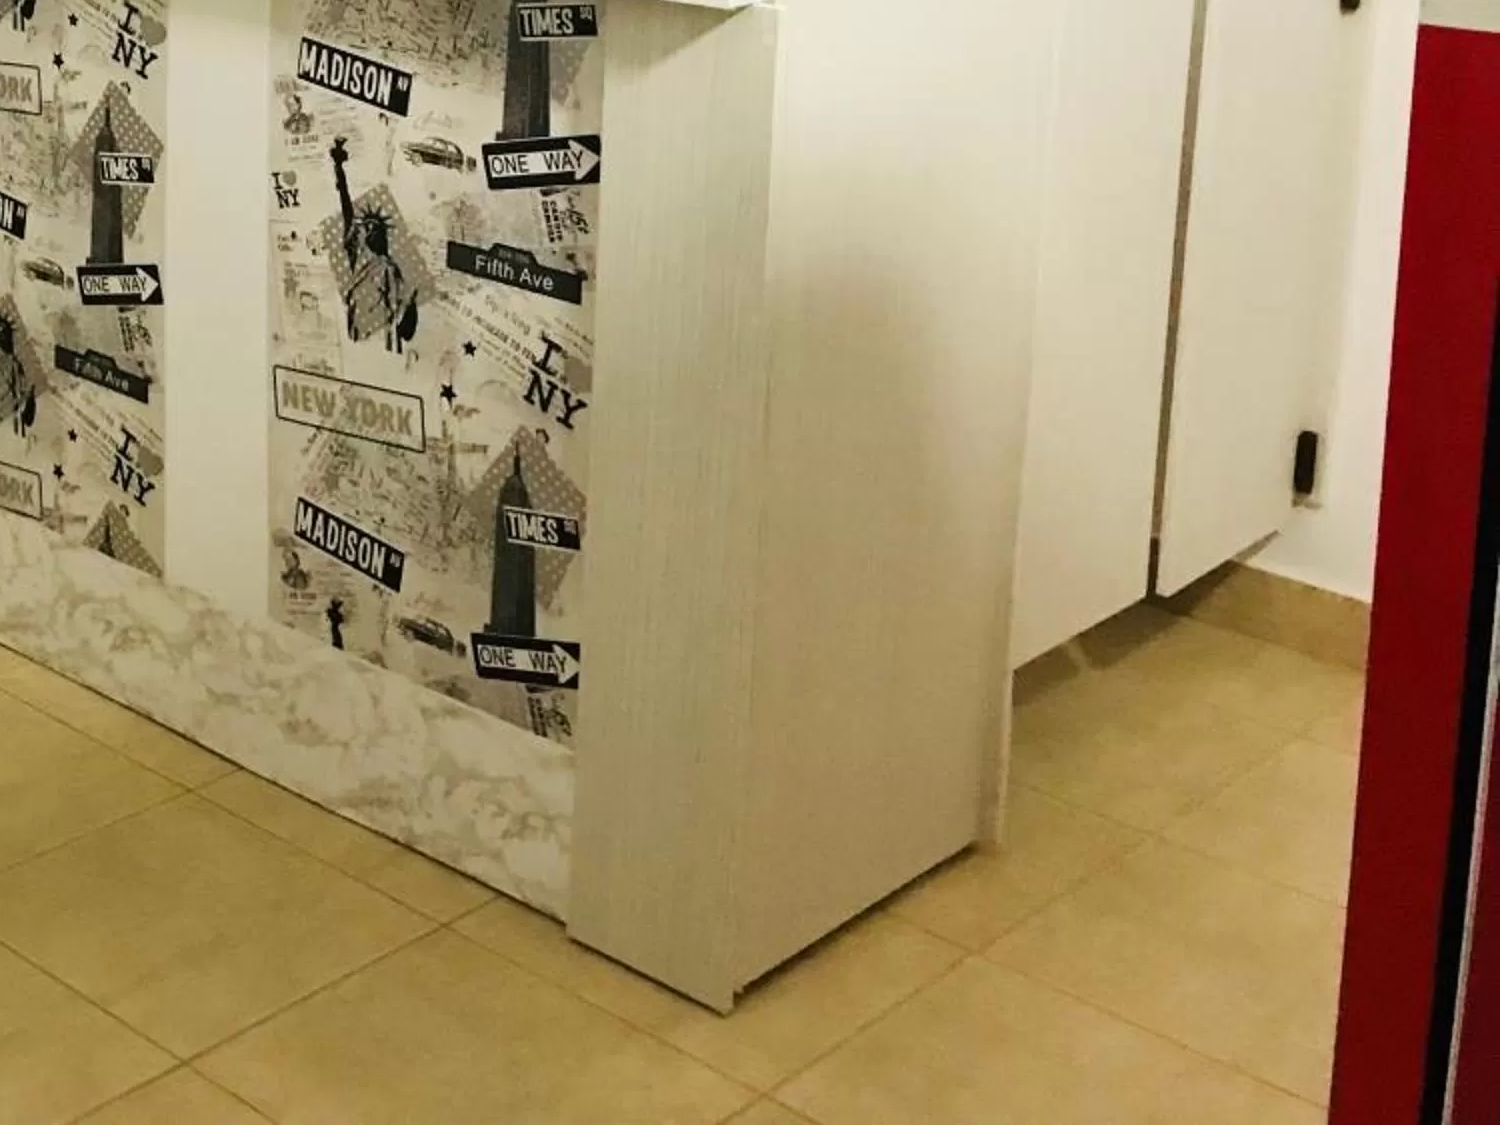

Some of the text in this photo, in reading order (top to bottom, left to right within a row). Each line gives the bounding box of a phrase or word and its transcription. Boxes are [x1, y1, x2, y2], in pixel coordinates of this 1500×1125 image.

[520, 7, 573, 34] TIMES
[112, 30, 158, 79] NY
[301, 42, 392, 106] MADISON
[102, 156, 138, 180] TIMES
[491, 150, 585, 175] ONE WAY
[275, 188, 300, 209] NY
[83, 276, 148, 293] ONE WAY
[475, 256, 554, 292] Fifth Ave
[535, 331, 566, 376] I
[281, 381, 413, 436] NEW YORK
[523, 370, 588, 429] NY
[116, 424, 140, 461] I
[110, 455, 156, 507] NY
[298, 505, 386, 579] MADISON
[507, 513, 559, 544] TIMES
[480, 648, 569, 674] ONE WAY
